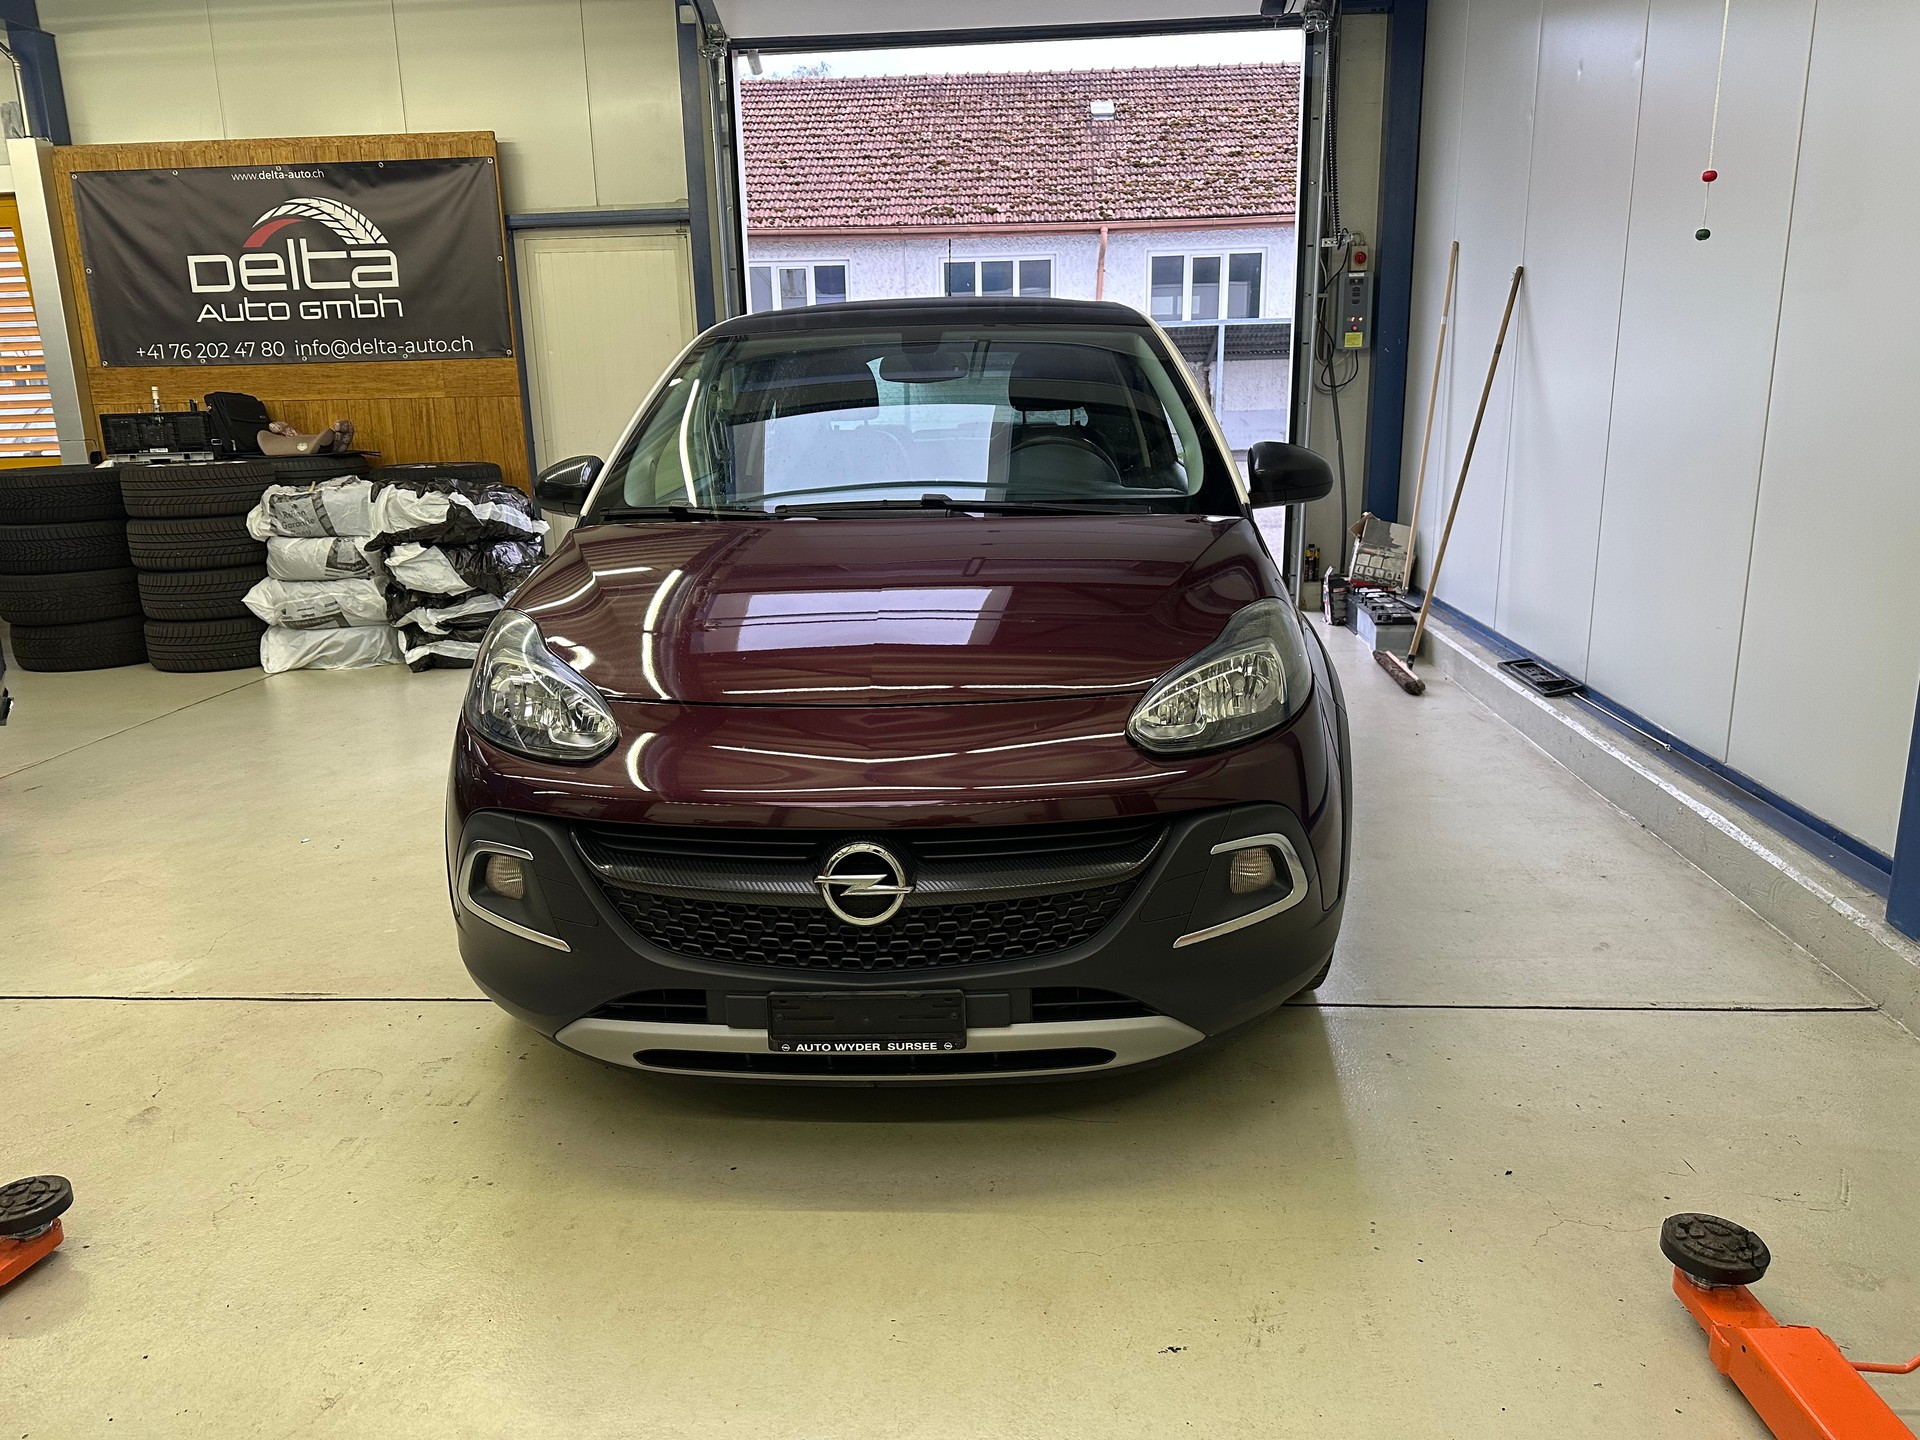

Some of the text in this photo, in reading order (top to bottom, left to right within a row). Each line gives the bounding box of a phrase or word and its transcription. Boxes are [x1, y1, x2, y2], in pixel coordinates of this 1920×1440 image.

[231, 168, 325, 181] www.delta-auto.ch
[187, 238, 399, 293] Delta
[197, 297, 290, 322] Auto
[136, 335, 474, 359] +41 76 202 47 80 info@delta-auto.ch
[796, 1042, 938, 1052] AUTO WYDER SURSEE
